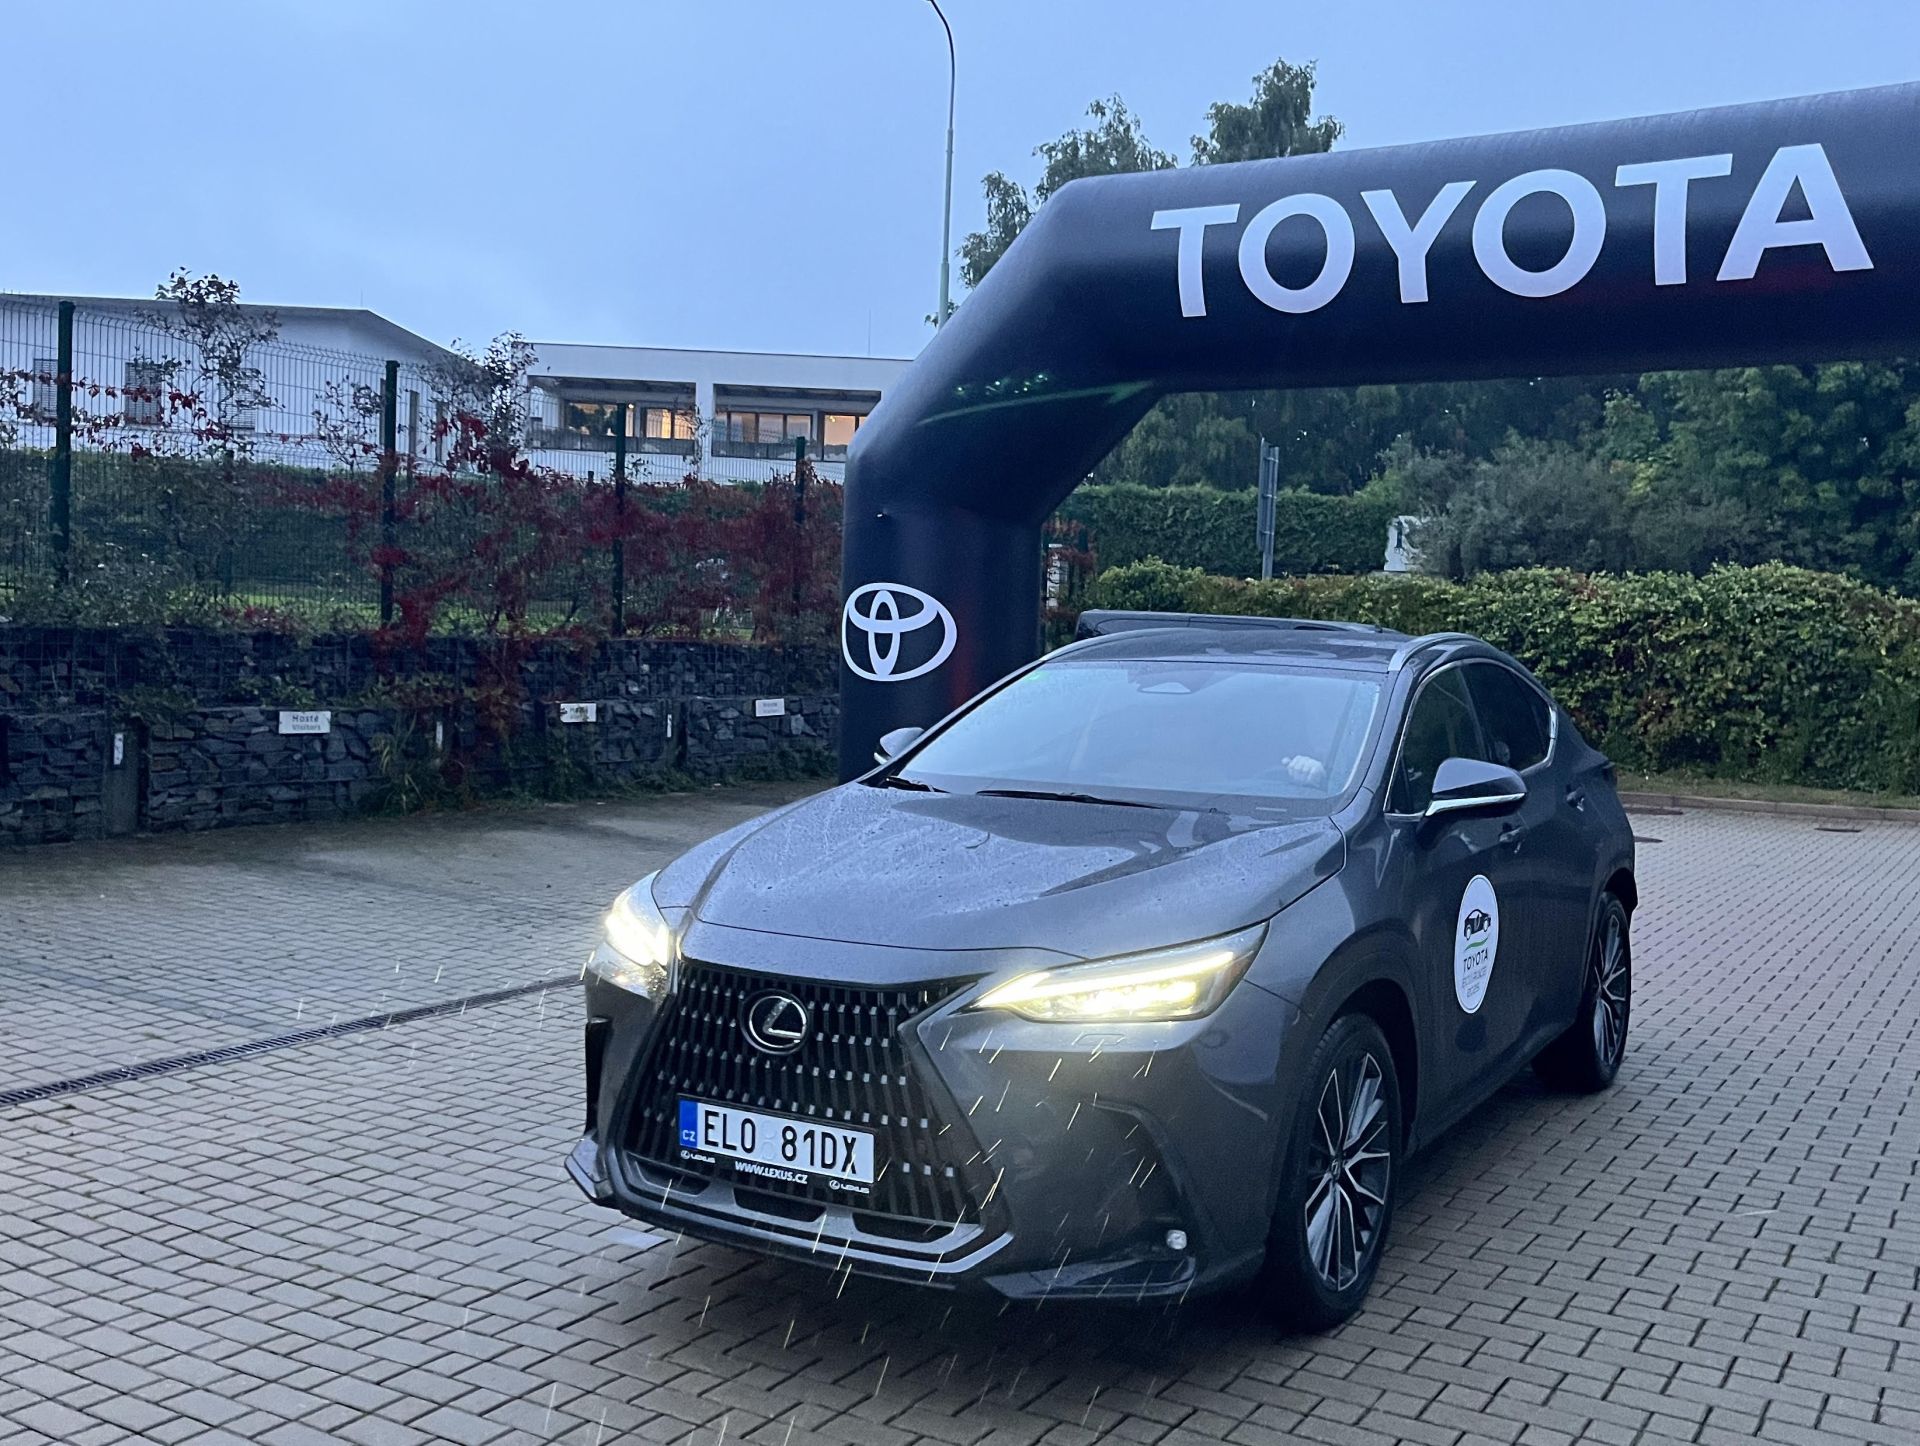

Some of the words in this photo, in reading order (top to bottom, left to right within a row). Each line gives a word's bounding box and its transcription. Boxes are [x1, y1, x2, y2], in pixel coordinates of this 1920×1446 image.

[1150, 143, 1874, 317] TOYOTA
[1463, 948, 1488, 973] TOYOTA
[682, 1129, 696, 1142] CZ
[781, 1125, 857, 1174] 81DX
[735, 1161, 808, 1184] WWW.LEXUS.CZ
